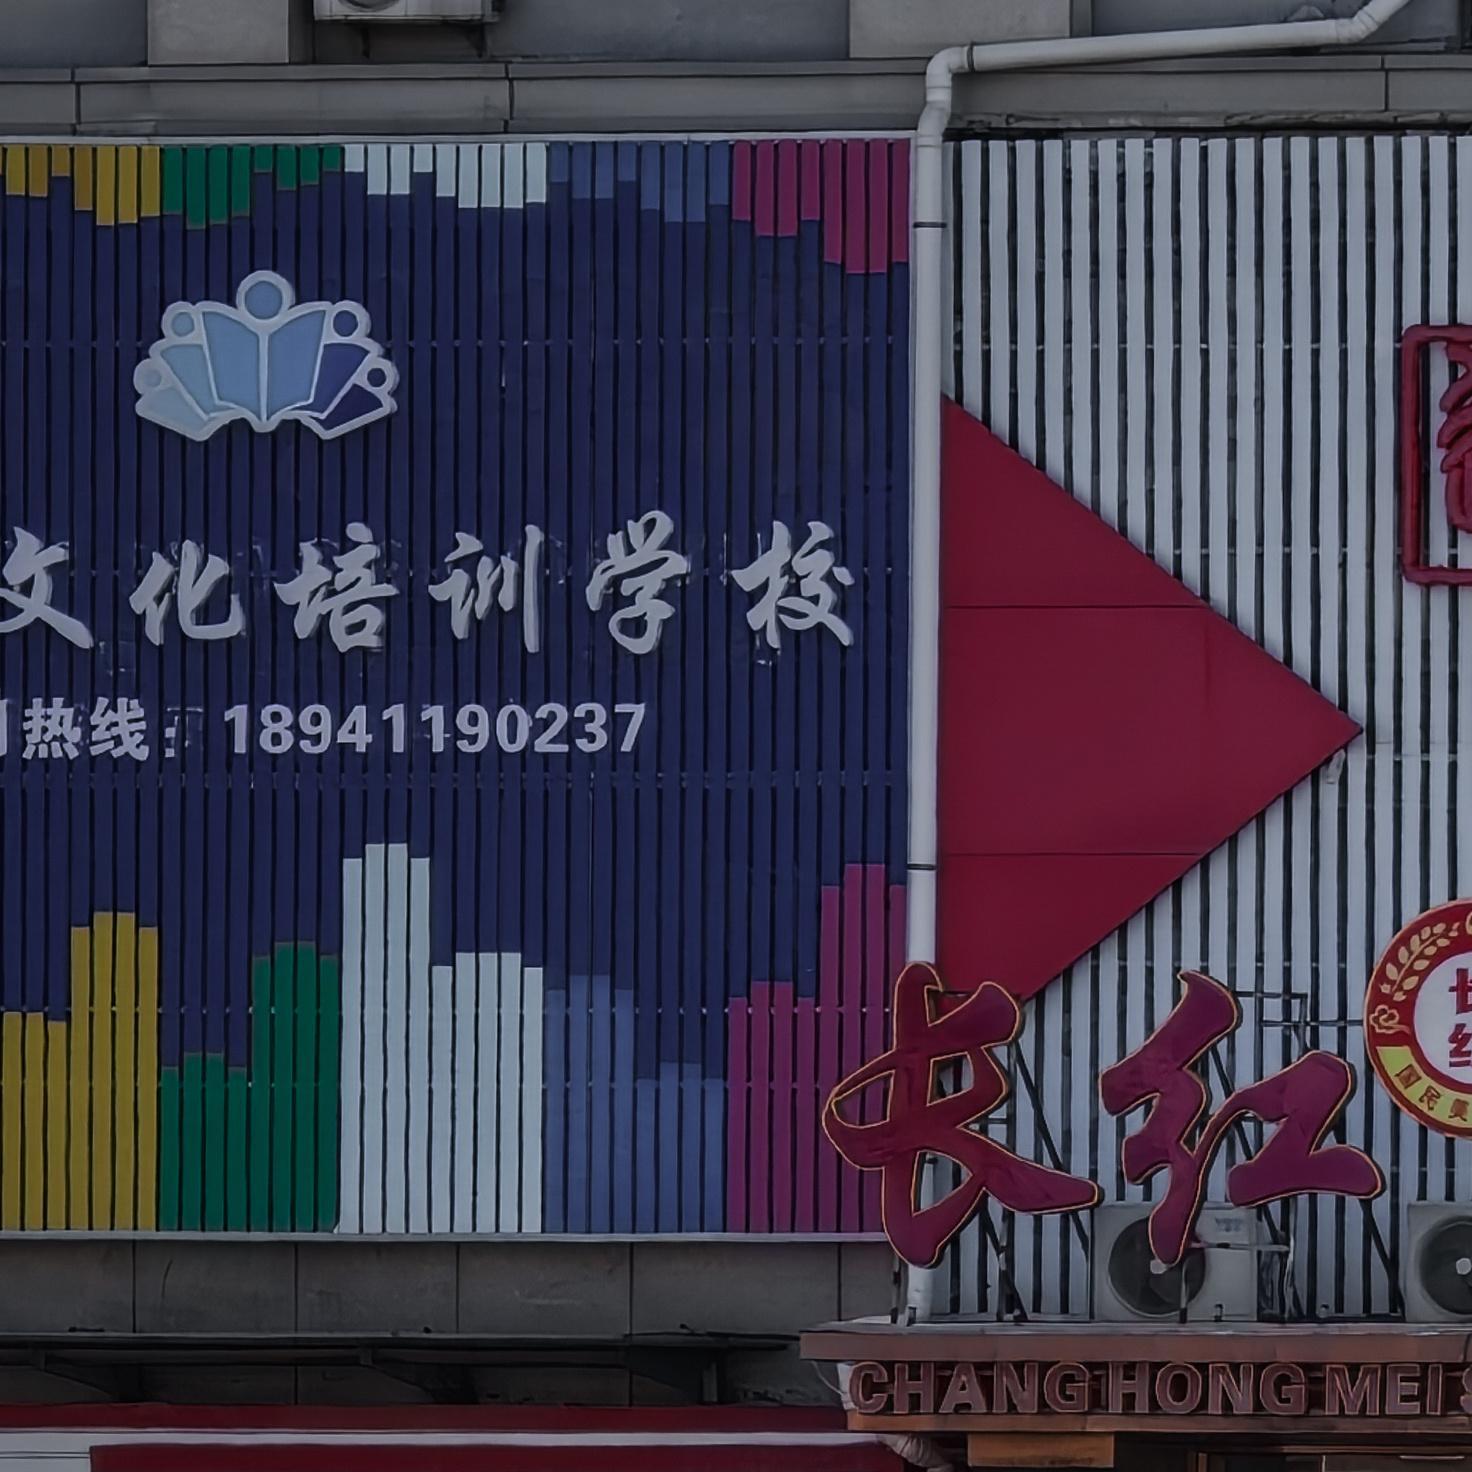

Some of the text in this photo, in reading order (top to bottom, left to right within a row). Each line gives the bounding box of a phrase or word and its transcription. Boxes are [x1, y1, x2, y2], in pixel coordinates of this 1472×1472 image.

[0, 510, 855, 655] 文化培训学校
[225, 702, 647, 754] 18941190237
[822, 961, 1386, 1268] 长红
[848, 1361, 1090, 1416] CHANG
[1109, 1361, 1304, 1416] HONG
[1325, 1363, 1443, 1417] MEI
